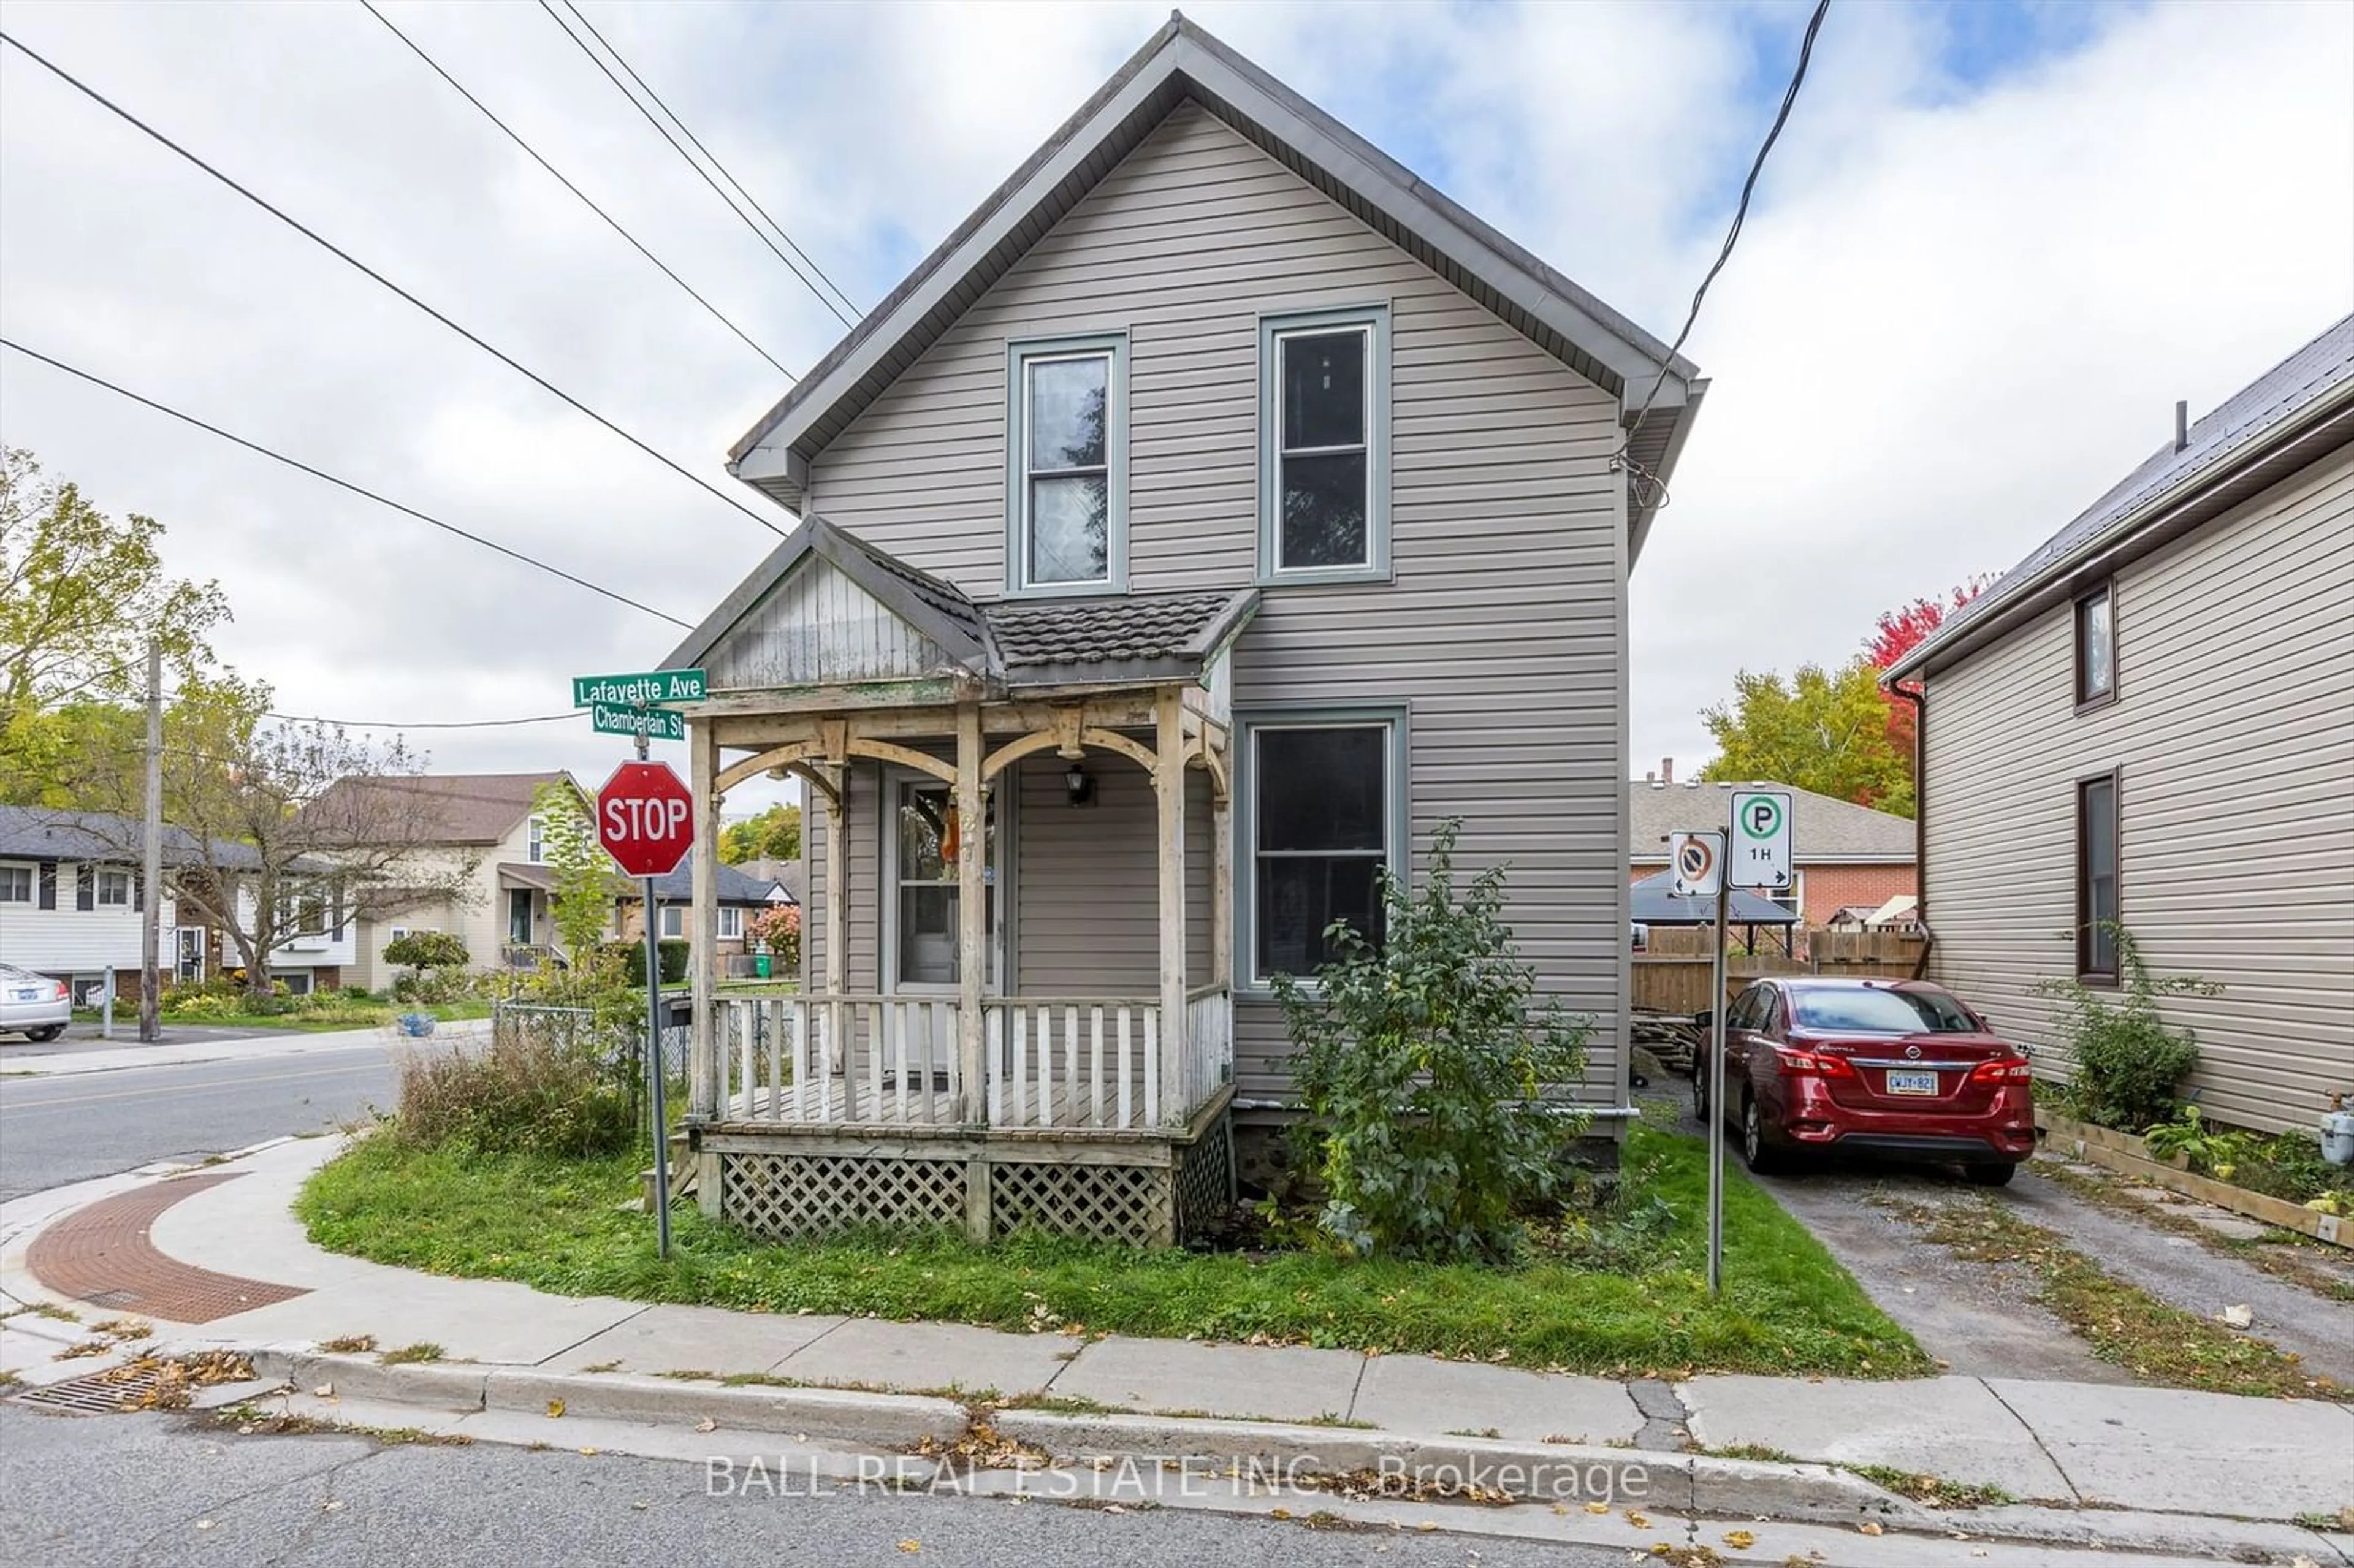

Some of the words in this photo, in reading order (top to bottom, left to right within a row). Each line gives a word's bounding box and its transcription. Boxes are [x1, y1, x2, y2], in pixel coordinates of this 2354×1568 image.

[579, 679, 661, 704] Lafayette
[669, 676, 700, 698] Ave
[595, 704, 666, 734] Chamberlain
[670, 714, 683, 736] St
[606, 797, 687, 842] STOP
